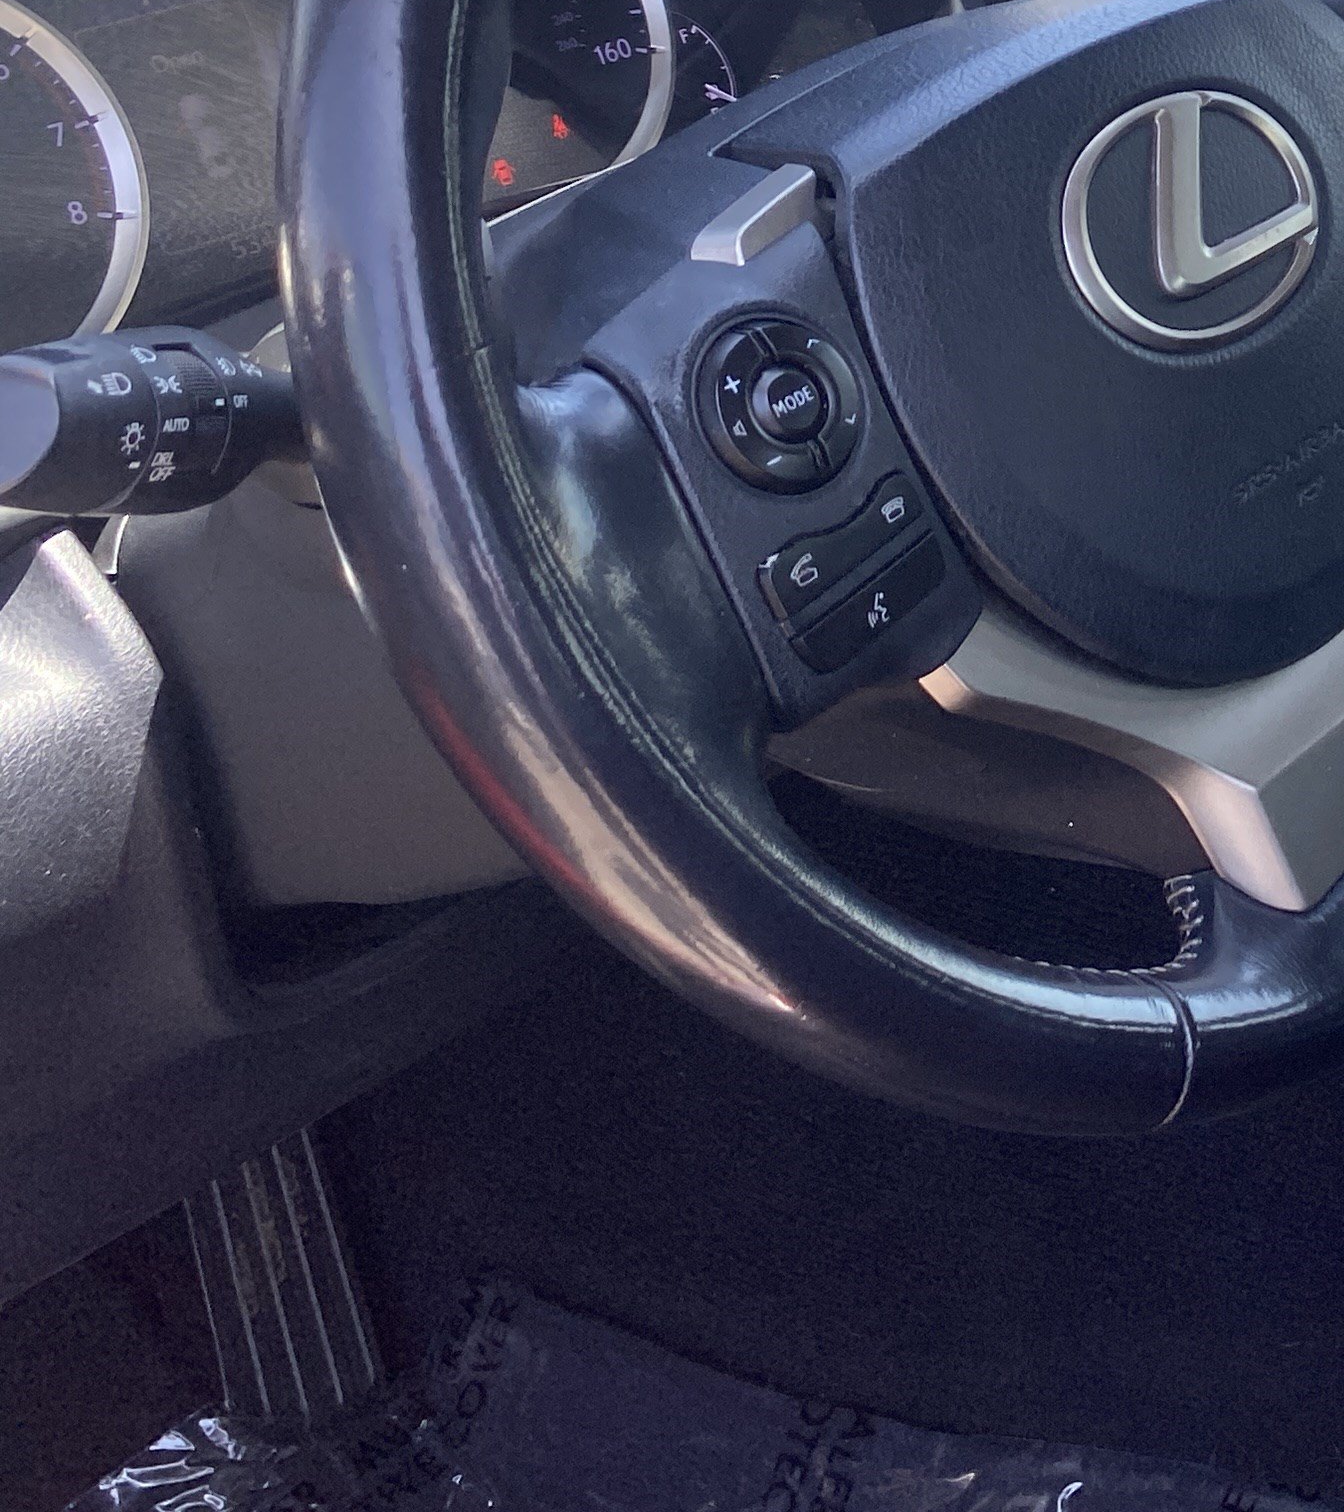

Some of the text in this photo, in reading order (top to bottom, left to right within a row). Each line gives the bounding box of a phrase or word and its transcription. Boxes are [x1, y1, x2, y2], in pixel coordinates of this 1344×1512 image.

[678, 28, 689, 44] F
[593, 38, 633, 65] 160
[46, 121, 63, 147] 7
[68, 200, 88, 225] 8
[233, 395, 249, 409] OFF
[772, 384, 816, 419] MODE
[163, 417, 190, 433] AUTO
[151, 452, 175, 467] DRL
[148, 465, 176, 483] OFF
